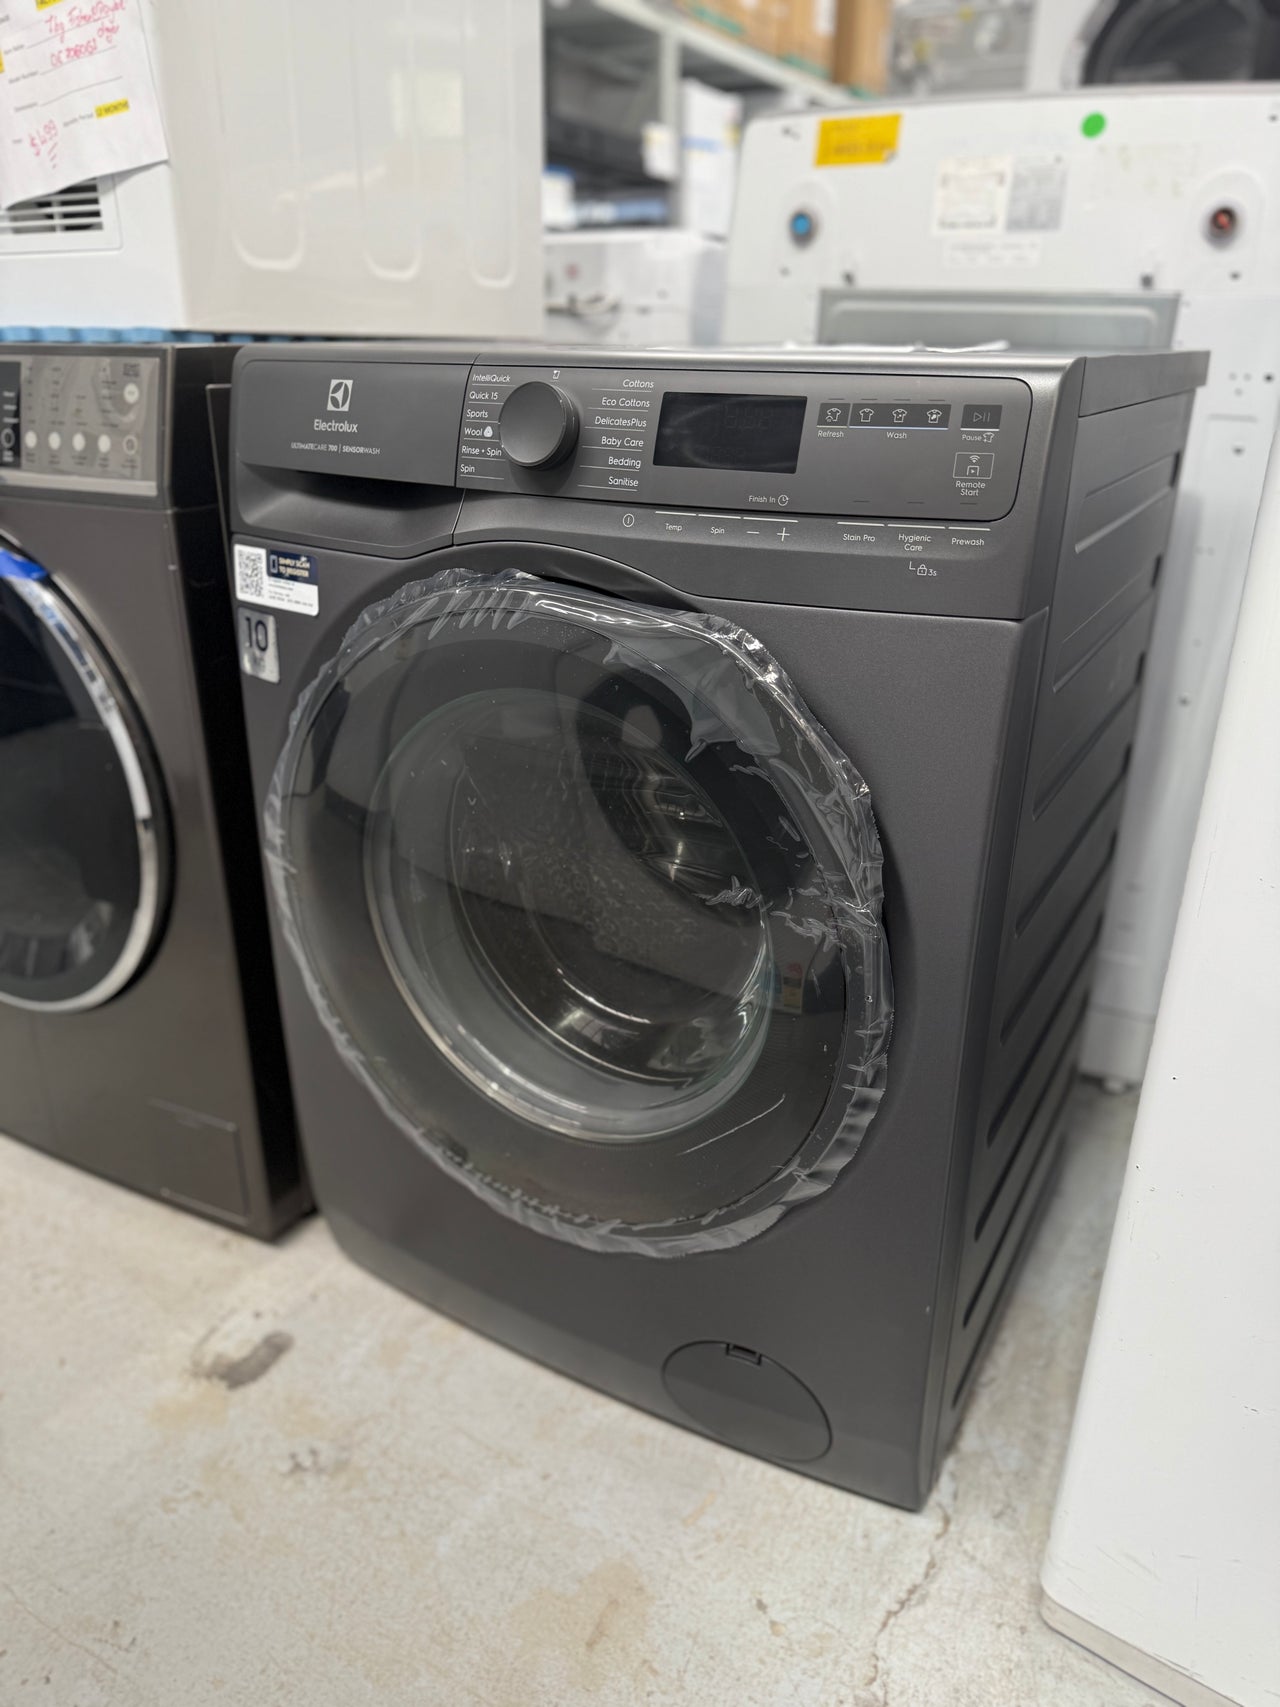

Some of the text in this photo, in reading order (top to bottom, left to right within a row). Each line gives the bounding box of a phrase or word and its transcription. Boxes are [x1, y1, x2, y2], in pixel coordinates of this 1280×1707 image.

[472, 373, 511, 383] IntelliQuick
[622, 379, 655, 389] Cottons
[469, 391, 498, 400] Quick 15
[601, 397, 651, 408] Eco Cottons
[466, 409, 489, 419] Sports
[314, 418, 358, 433] Electrolux
[594, 416, 647, 428] DelicatesPlus
[464, 427, 483, 436] Wool
[817, 430, 844, 438] Refresh
[886, 431, 908, 440] Wash
[601, 436, 644, 448] Baby Care
[962, 434, 982, 442] Pause
[290, 442, 380, 455] ULTIMATECARE 700 SENSORWASH
[461, 446, 502, 458] Rinse Spin
[608, 456, 642, 468] Bedding
[460, 464, 476, 474] Spin
[608, 476, 640, 488] Sanitise
[955, 480, 986, 489] Remote
[960, 488, 979, 496] Start
[748, 495, 776, 504] Finish In
[665, 523, 683, 532] Temp
[710, 526, 725, 535] Spin
[842, 534, 876, 543] Stain Pro
[898, 534, 932, 543] Hygienic
[951, 538, 985, 546] Prewash
[904, 543, 923, 552] Care
[928, 568, 938, 577] 3s
[244, 616, 268, 652] 10
